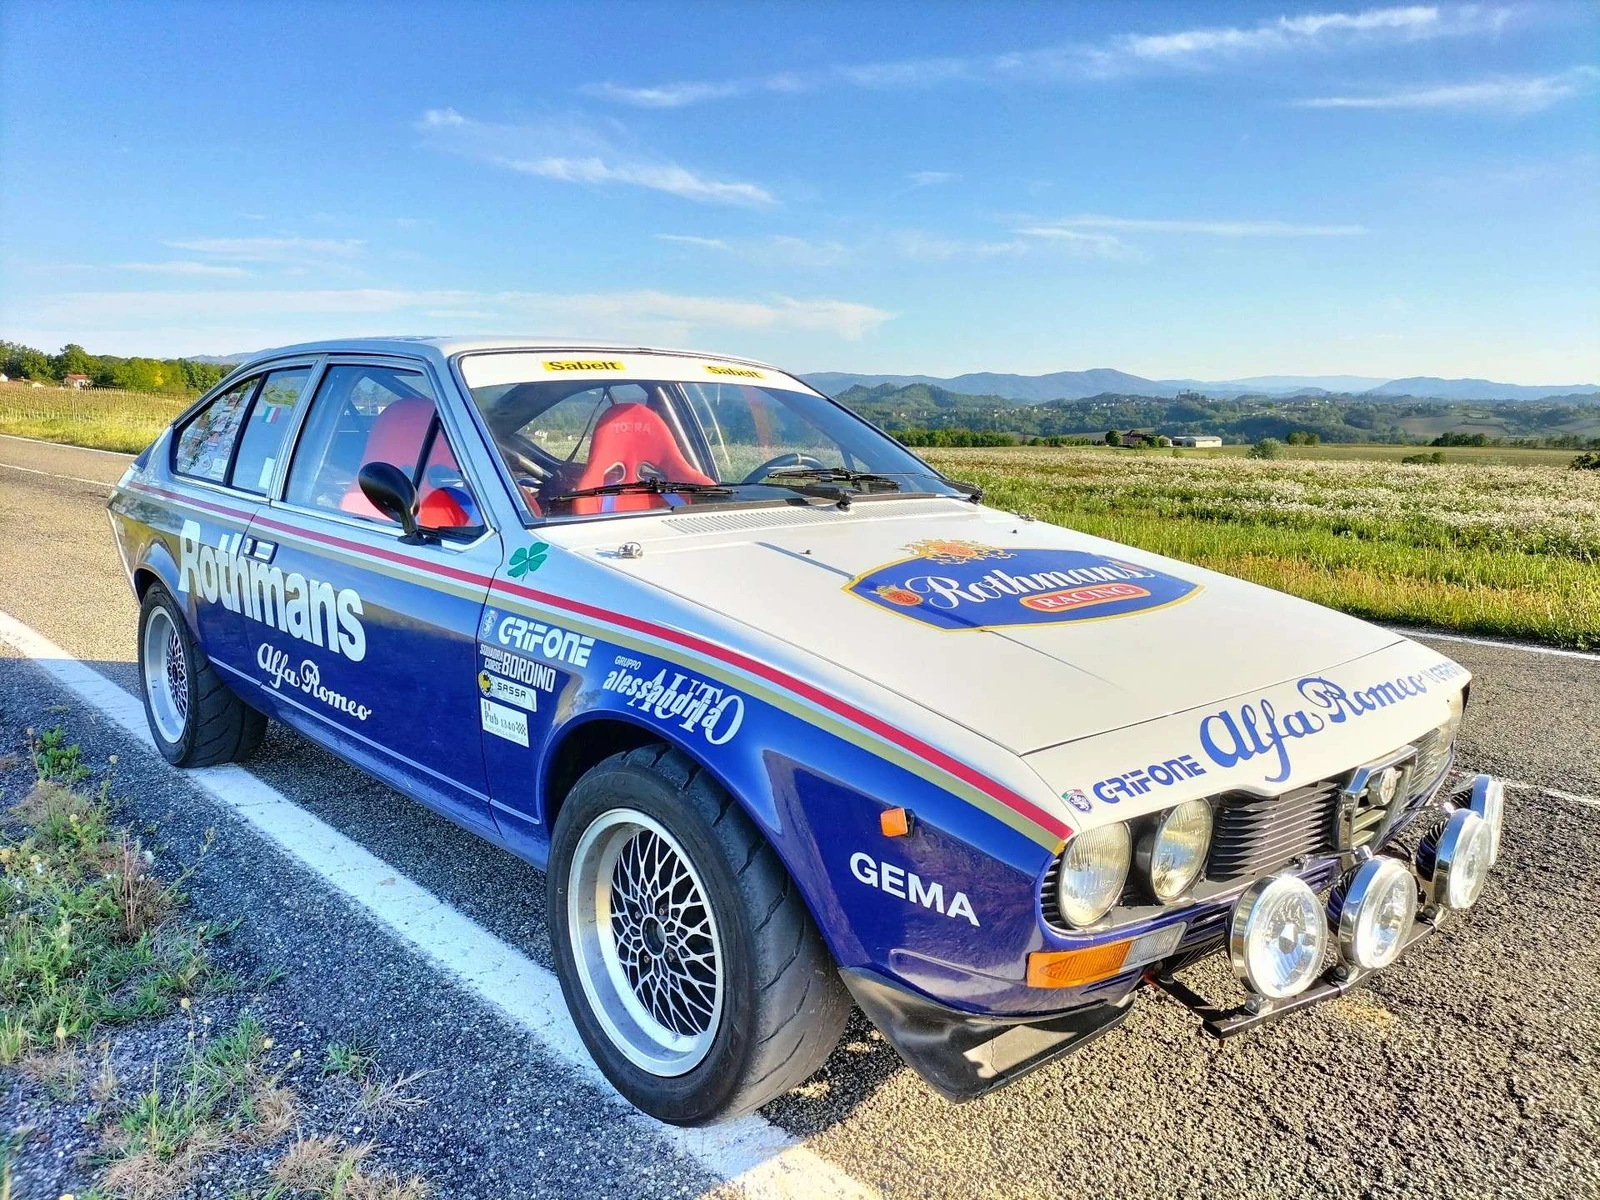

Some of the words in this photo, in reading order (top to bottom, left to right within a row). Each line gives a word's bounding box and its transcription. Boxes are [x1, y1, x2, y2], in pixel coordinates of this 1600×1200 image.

[548, 361, 619, 371] Sabelt
[707, 366, 762, 378] Sabelt
[178, 519, 367, 662] Rothmans
[904, 562, 1156, 610] Rothmans
[1035, 585, 1136, 608] RACING
[498, 616, 595, 668] GRIFONE
[614, 655, 642, 671] GRUPPO
[256, 642, 301, 688] Alfa
[300, 659, 372, 721] Romeo
[497, 682, 527, 699] SASSA
[502, 652, 557, 693] BORDINO
[484, 711, 499, 725] Pub
[602, 669, 722, 730] alessandria
[1199, 699, 1325, 783] Alfa
[1297, 676, 1427, 723] Romeo
[1092, 754, 1207, 804] GRIFONE
[849, 851, 981, 927] GEMA
